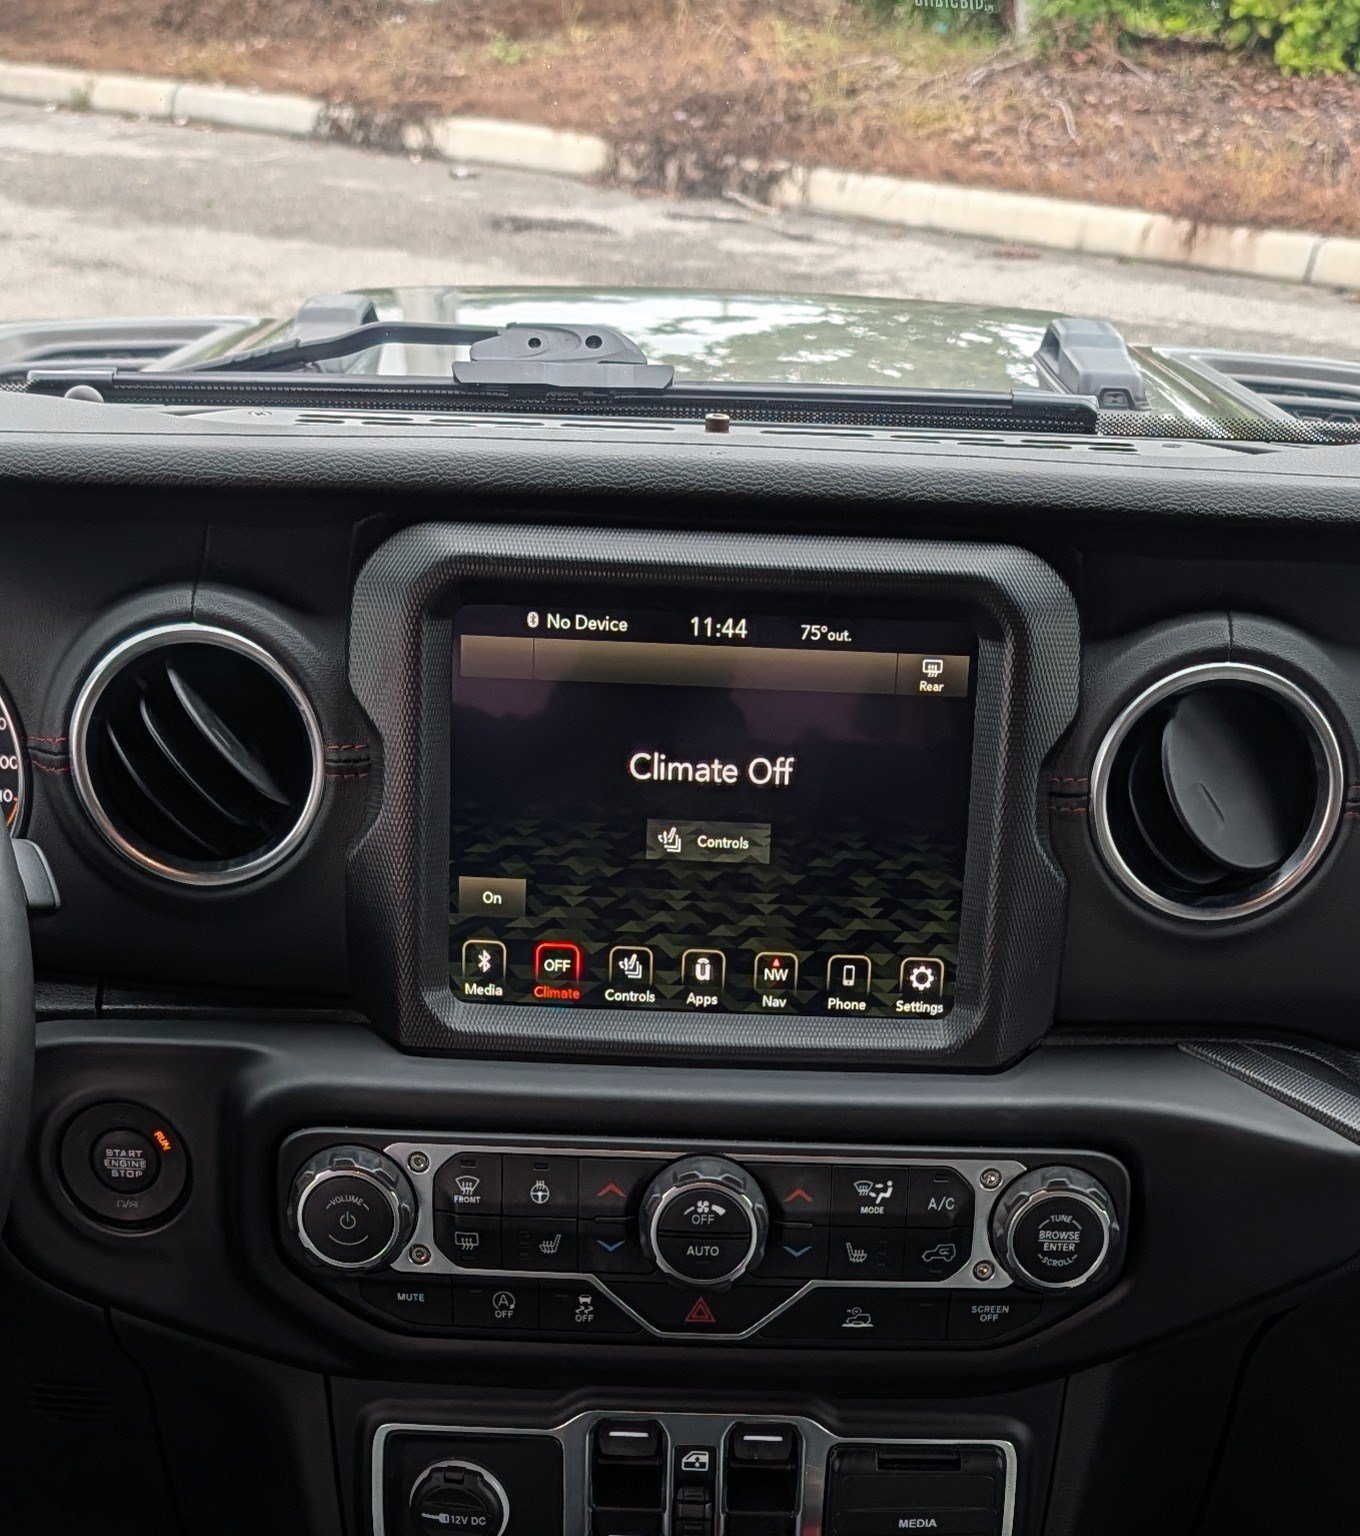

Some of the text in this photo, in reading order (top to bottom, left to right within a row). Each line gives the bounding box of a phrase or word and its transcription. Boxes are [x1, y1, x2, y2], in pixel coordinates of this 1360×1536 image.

[547, 614, 628, 633] No Device
[690, 616, 748, 639] 11:44
[919, 680, 944, 693] Rear
[629, 752, 795, 787] Climate Off
[696, 834, 750, 851] Controls
[482, 890, 502, 906] On
[543, 958, 571, 974] OFF
[763, 967, 789, 983] NW
[464, 982, 503, 998] Media
[534, 984, 580, 1001] Climate
[604, 988, 656, 1005] Controls
[686, 992, 719, 1009] Apps
[762, 995, 787, 1009] Nav
[827, 996, 867, 1013] Phone
[895, 999, 944, 1018] Settings
[153, 1130, 172, 1151] RUN
[105, 1148, 143, 1157] START
[104, 1159, 146, 1168] ENGINE
[111, 1169, 143, 1178] STOP
[330, 1195, 365, 1207] VOLUME
[454, 1195, 481, 1204] FRONT
[928, 1196, 955, 1211] A/C
[860, 1205, 885, 1215] MODE
[691, 1214, 715, 1226] OFF
[1050, 1214, 1072, 1224] TUNE
[1038, 1230, 1081, 1241] BROWSE
[686, 1245, 720, 1258] AUTO
[1043, 1242, 1076, 1253] ENTER
[1041, 1255, 1074, 1268] SCROLL
[397, 1292, 425, 1303] MUTE
[495, 1309, 514, 1319] OFF
[971, 1305, 1010, 1314] SCREEN
[575, 1313, 594, 1323] OFF
[979, 1313, 999, 1322] OFF
[450, 1513, 487, 1526] 12V DC
[898, 1518, 937, 1529] MEDIA
